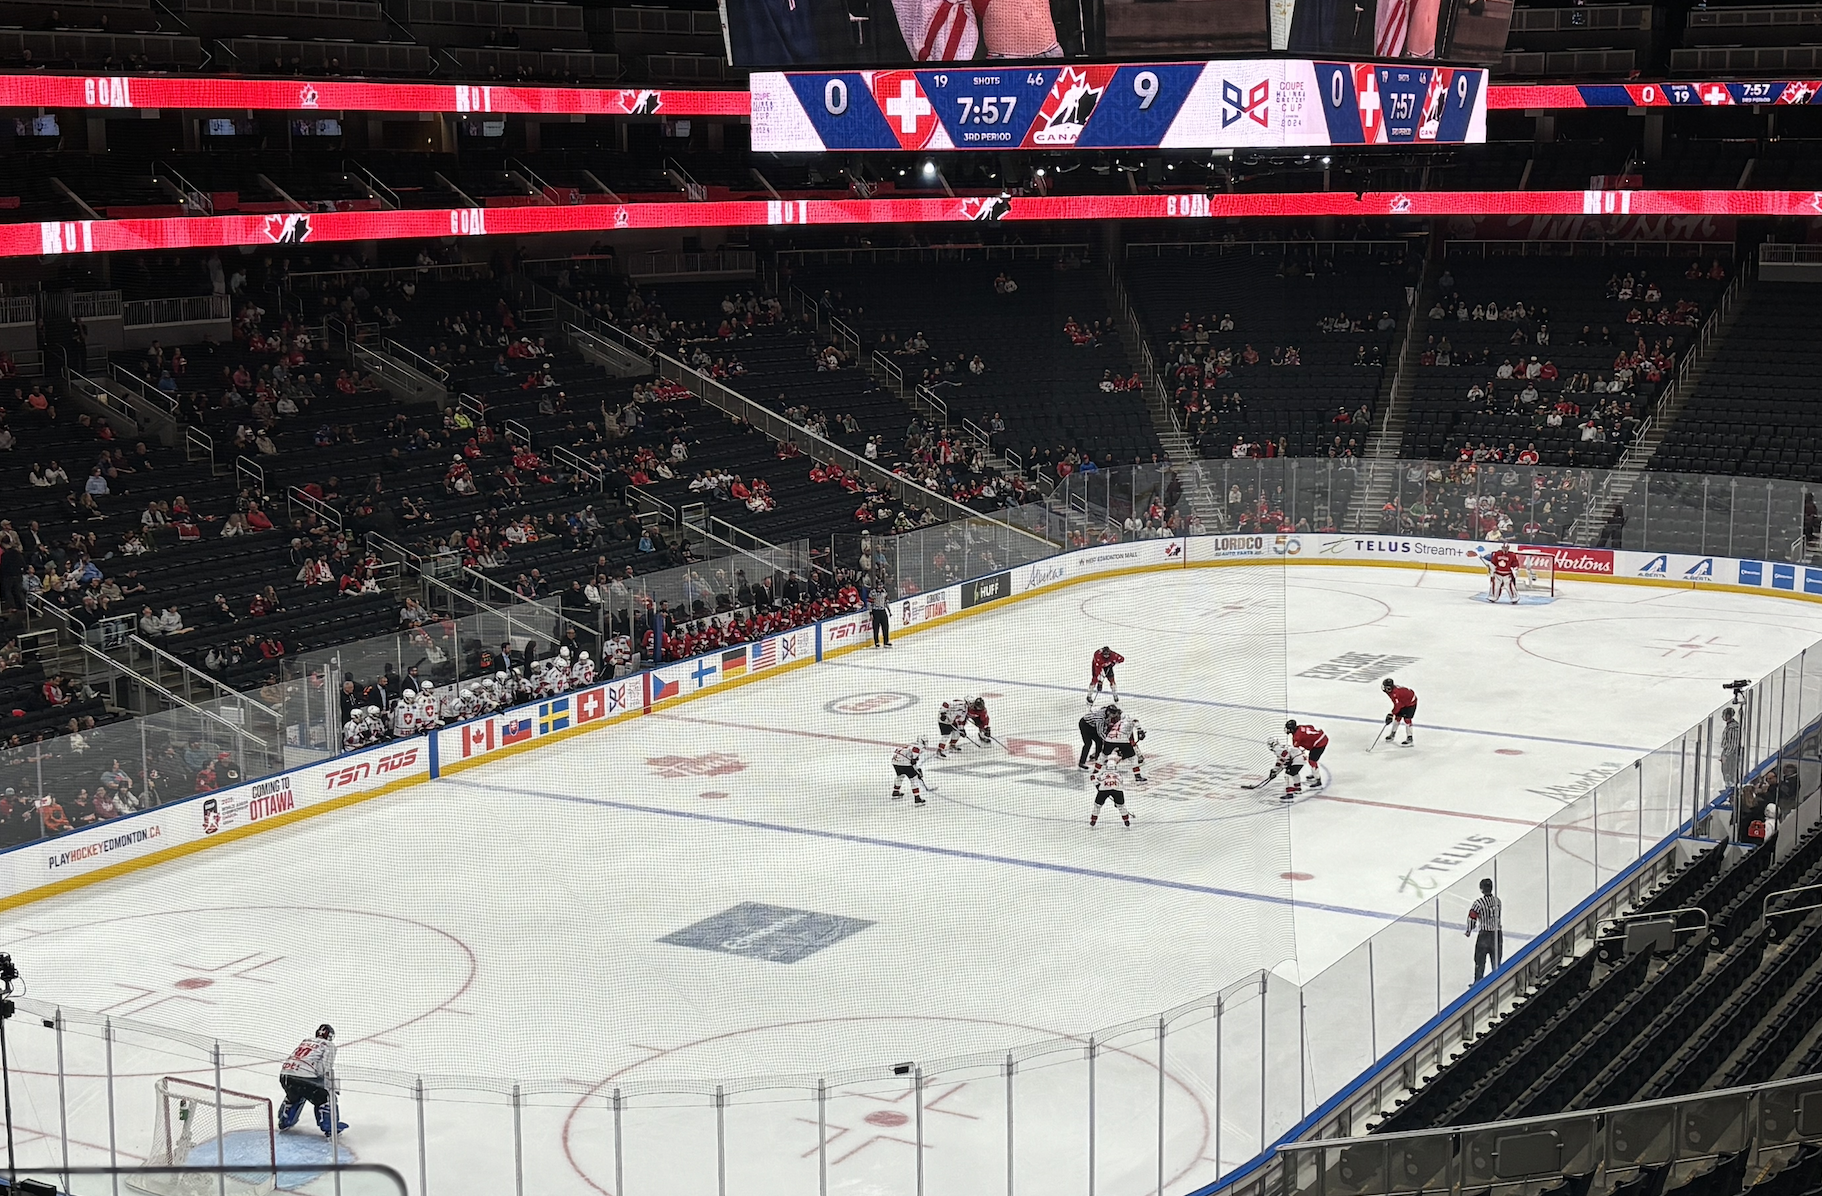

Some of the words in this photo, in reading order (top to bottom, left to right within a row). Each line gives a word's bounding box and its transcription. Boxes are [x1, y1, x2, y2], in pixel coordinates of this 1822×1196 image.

[933, 75, 948, 88] 19
[973, 76, 1001, 86] SHOTS
[1027, 73, 1044, 86] 46
[1133, 71, 1160, 110] 9
[1331, 69, 1344, 108] 0
[1742, 84, 1771, 96] 7:57
[84, 77, 133, 107] GOAL
[825, 79, 847, 115] 0
[1457, 75, 1468, 109] 9
[1641, 86, 1655, 103] 0
[1674, 91, 1690, 103] 19
[957, 96, 1017, 125] 7:57
[1281, 104, 1303, 112] CUP
[1390, 93, 1416, 119] 7:57
[963, 132, 981, 142] 3RD
[982, 132, 1012, 142] PERIOD
[1166, 194, 1213, 218] GOAL
[451, 208, 487, 236] GOAL
[1214, 537, 1263, 551] LORDCO
[1354, 540, 1411, 553] TELUS
[1414, 542, 1464, 557] Stream+
[1554, 549, 1612, 572] Hortons
[980, 582, 1000, 599] HUFF
[828, 622, 856, 641] TSN
[325, 762, 371, 790] TSN
[376, 747, 419, 775] RDS
[252, 780, 280, 799] COMING
[281, 776, 290, 790] TO
[249, 790, 295, 821] OTTAWA
[1418, 833, 1497, 872] TELUS
